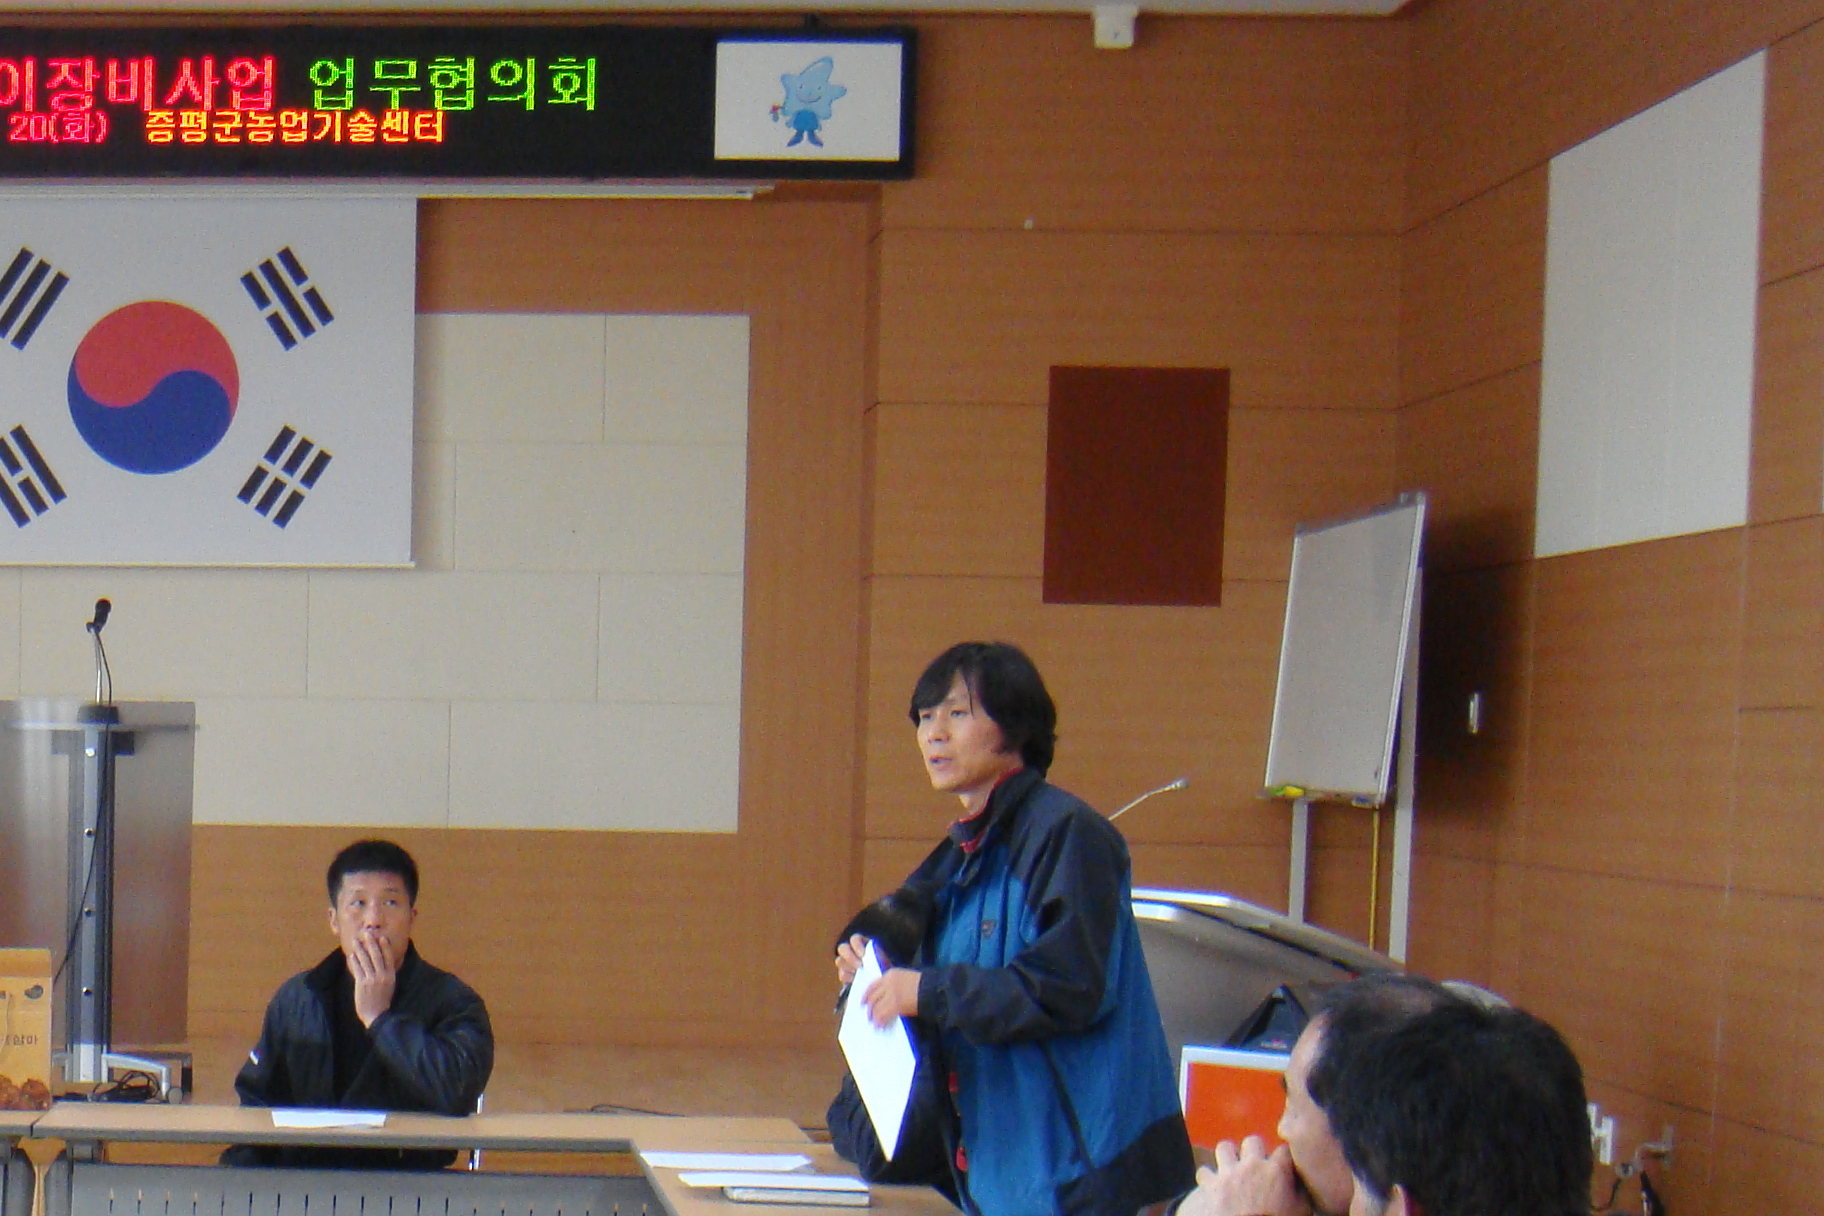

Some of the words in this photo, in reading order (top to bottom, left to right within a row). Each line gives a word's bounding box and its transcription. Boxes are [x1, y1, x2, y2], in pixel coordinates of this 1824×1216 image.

[308, 55, 597, 112] 업무협의회
[9, 111, 109, 144] 20(화)
[144, 110, 445, 143] 증평군농업기술센터
